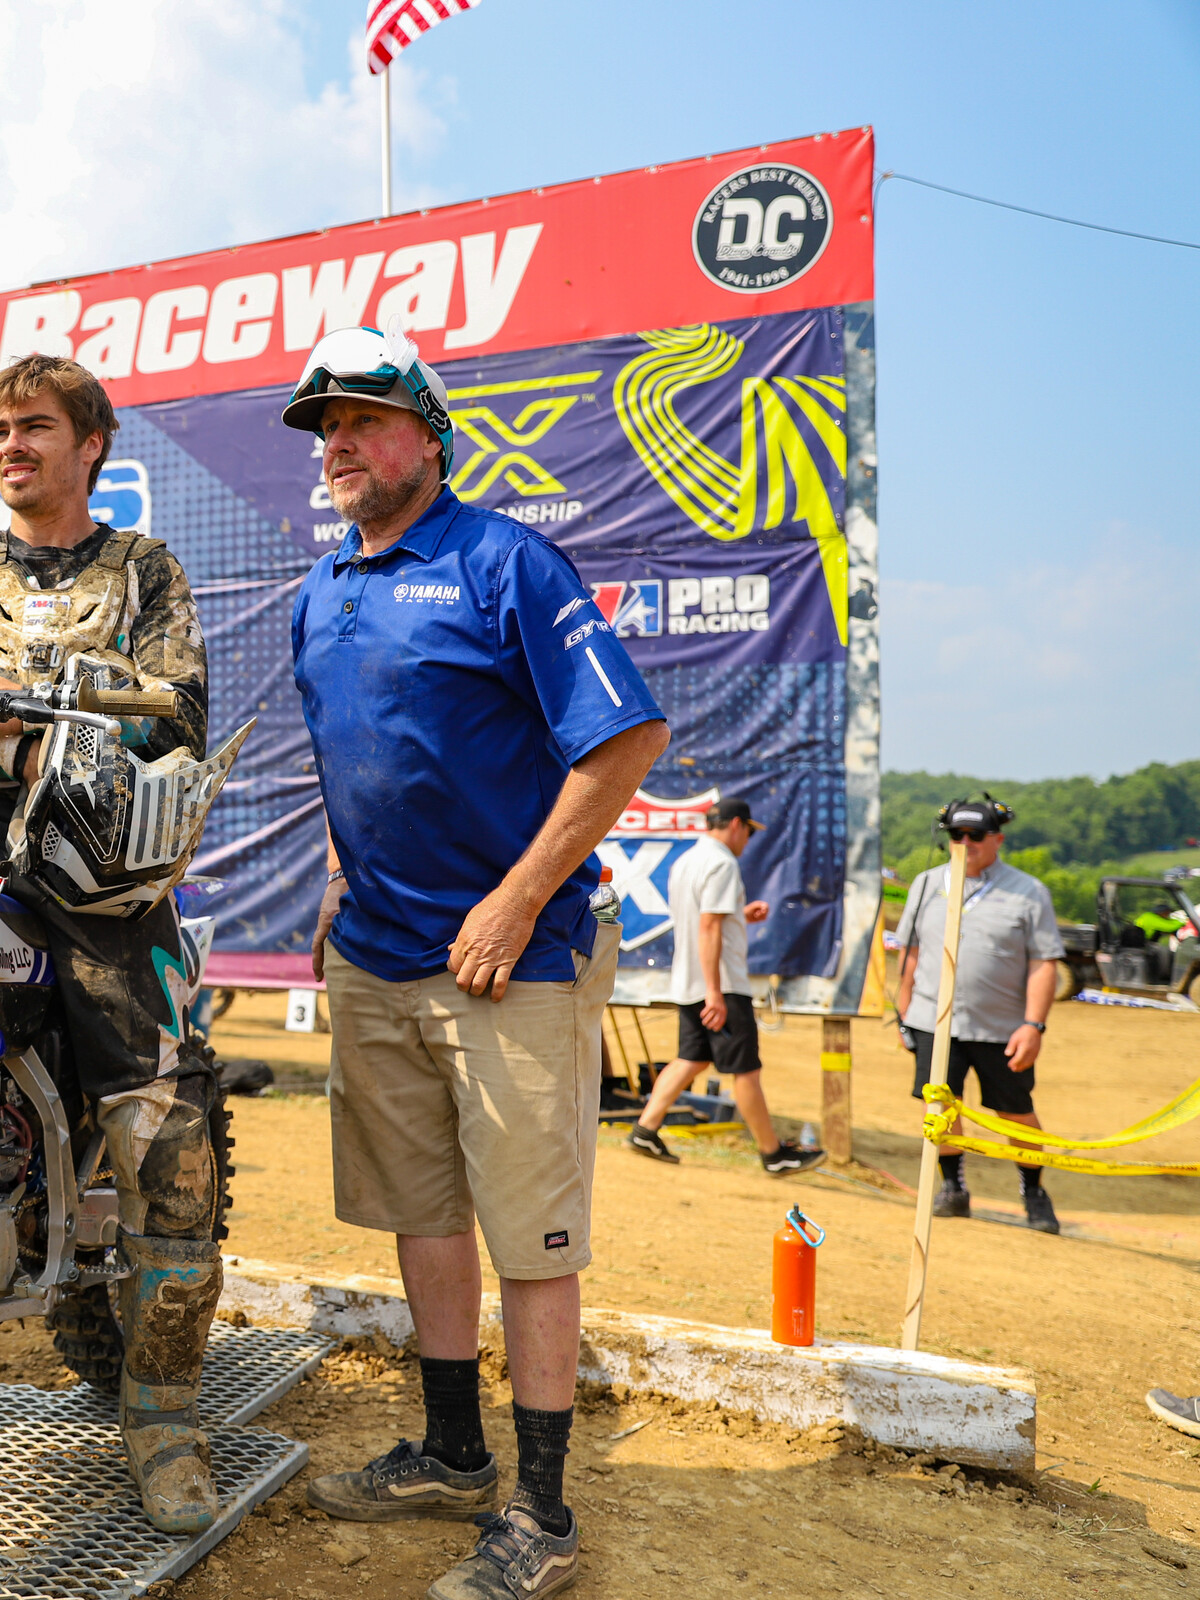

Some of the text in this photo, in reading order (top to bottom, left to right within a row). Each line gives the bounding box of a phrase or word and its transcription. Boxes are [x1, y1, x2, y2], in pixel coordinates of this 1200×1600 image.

[702, 169, 825, 223] RACERS BEST FRIEND!
[716, 195, 807, 261] DC
[719, 267, 789, 287] 1941-1998
[0, 222, 544, 380] Raceway
[409, 585, 460, 600] YAMAHA
[668, 574, 770, 615] PRO
[668, 612, 770, 635] RACING
[615, 810, 708, 830] CER
[13, 947, 32, 968] LLC
[295, 1006, 306, 1023] 3
